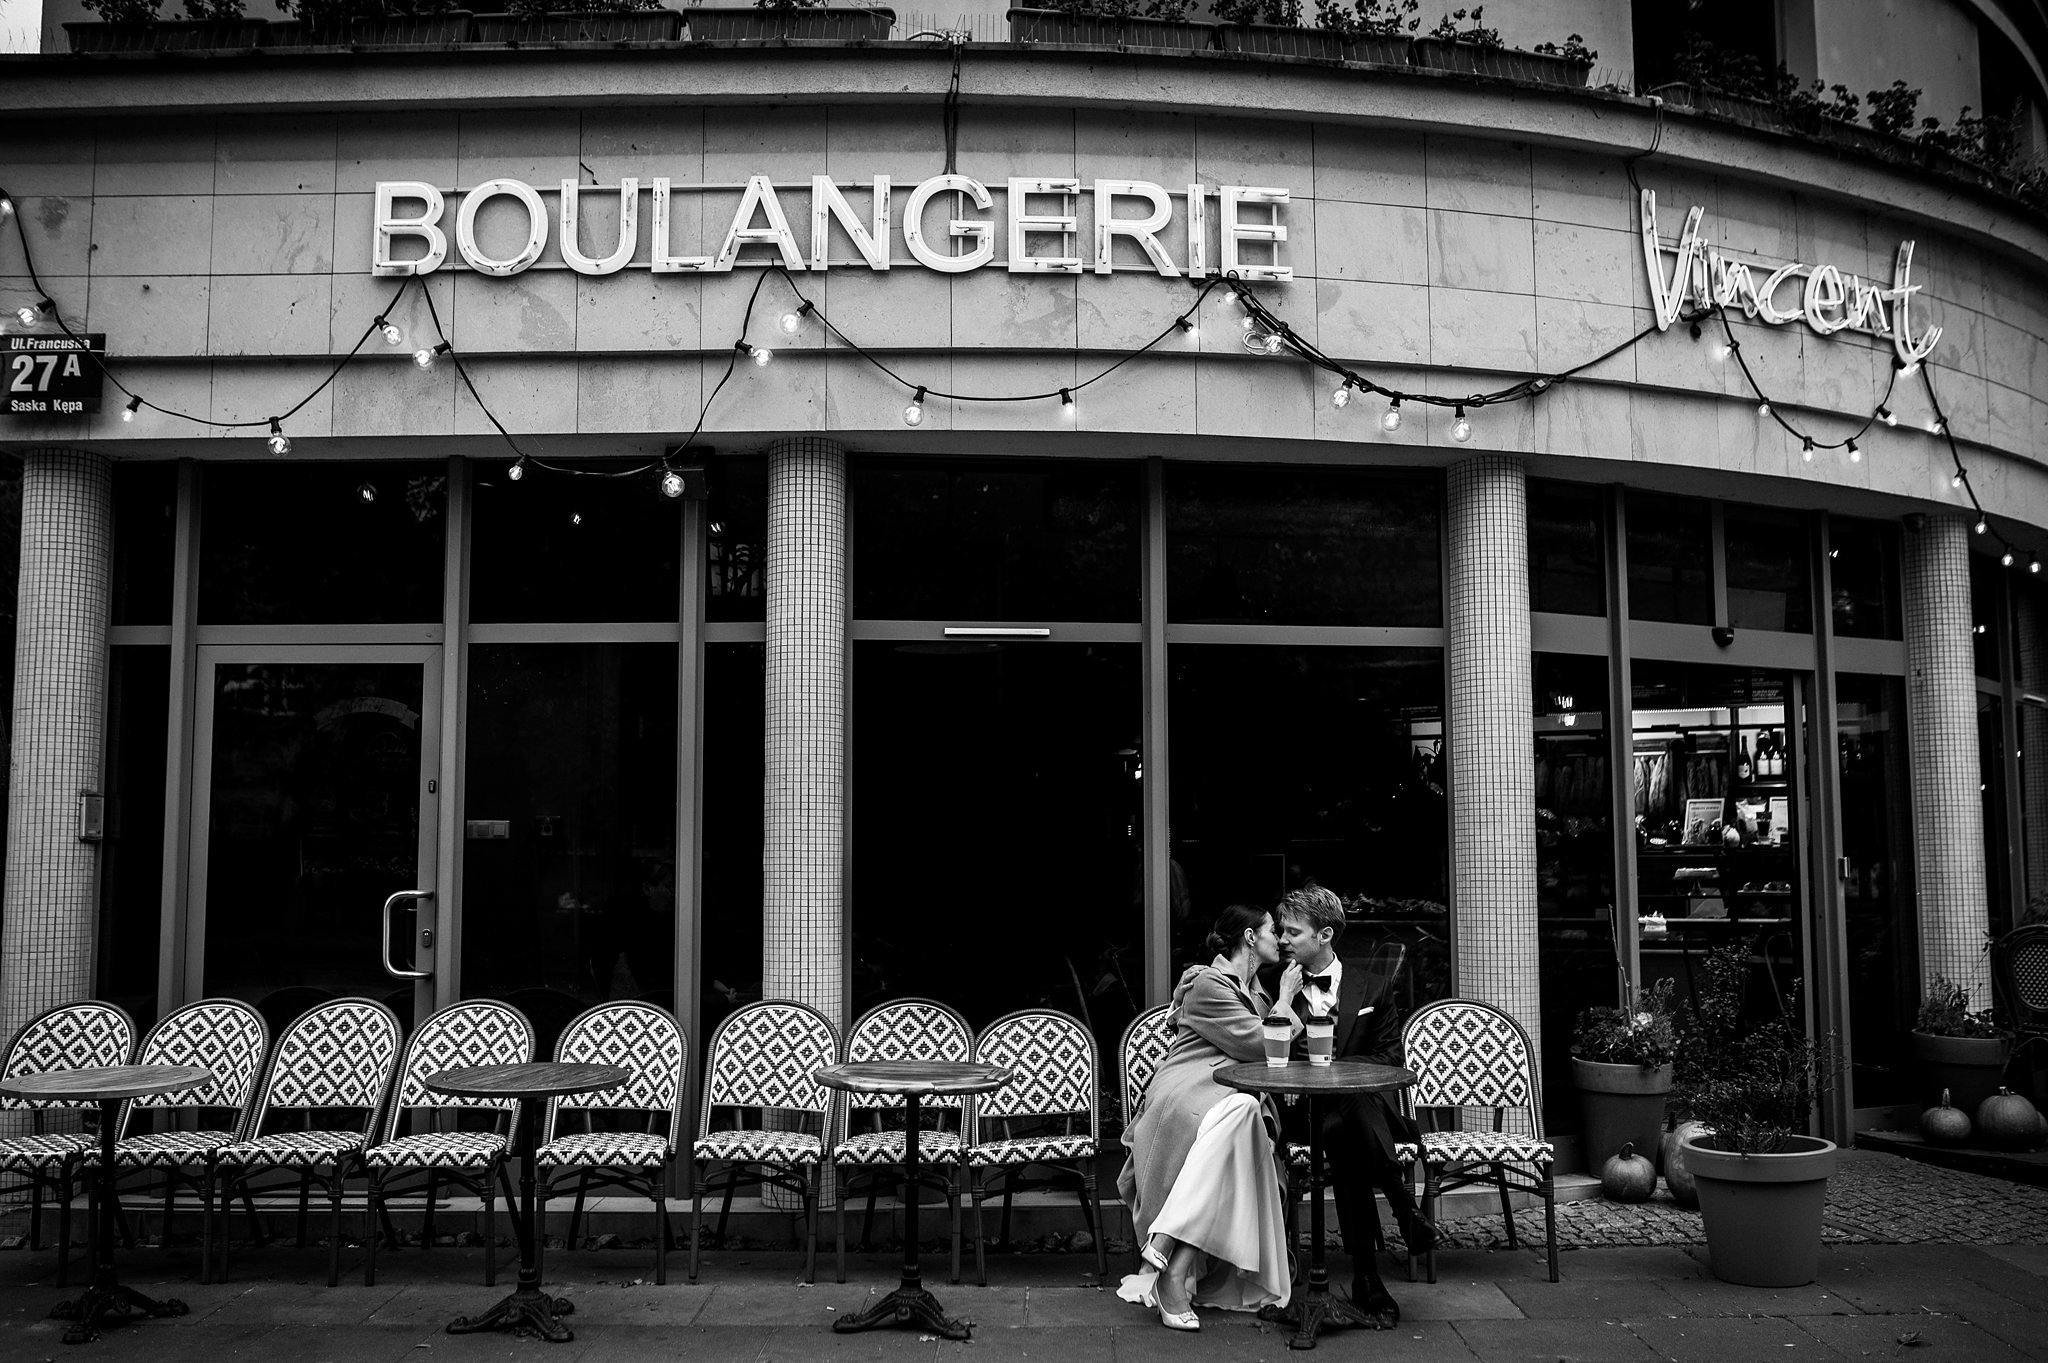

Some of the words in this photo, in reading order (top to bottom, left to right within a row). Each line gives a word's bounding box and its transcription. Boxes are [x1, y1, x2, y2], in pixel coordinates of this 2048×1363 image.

[372, 174, 1294, 282] BOULANGERIE
[1641, 188, 1943, 366] Vincent
[11, 399, 46, 411] Saska
[53, 399, 83, 413] Kępa
